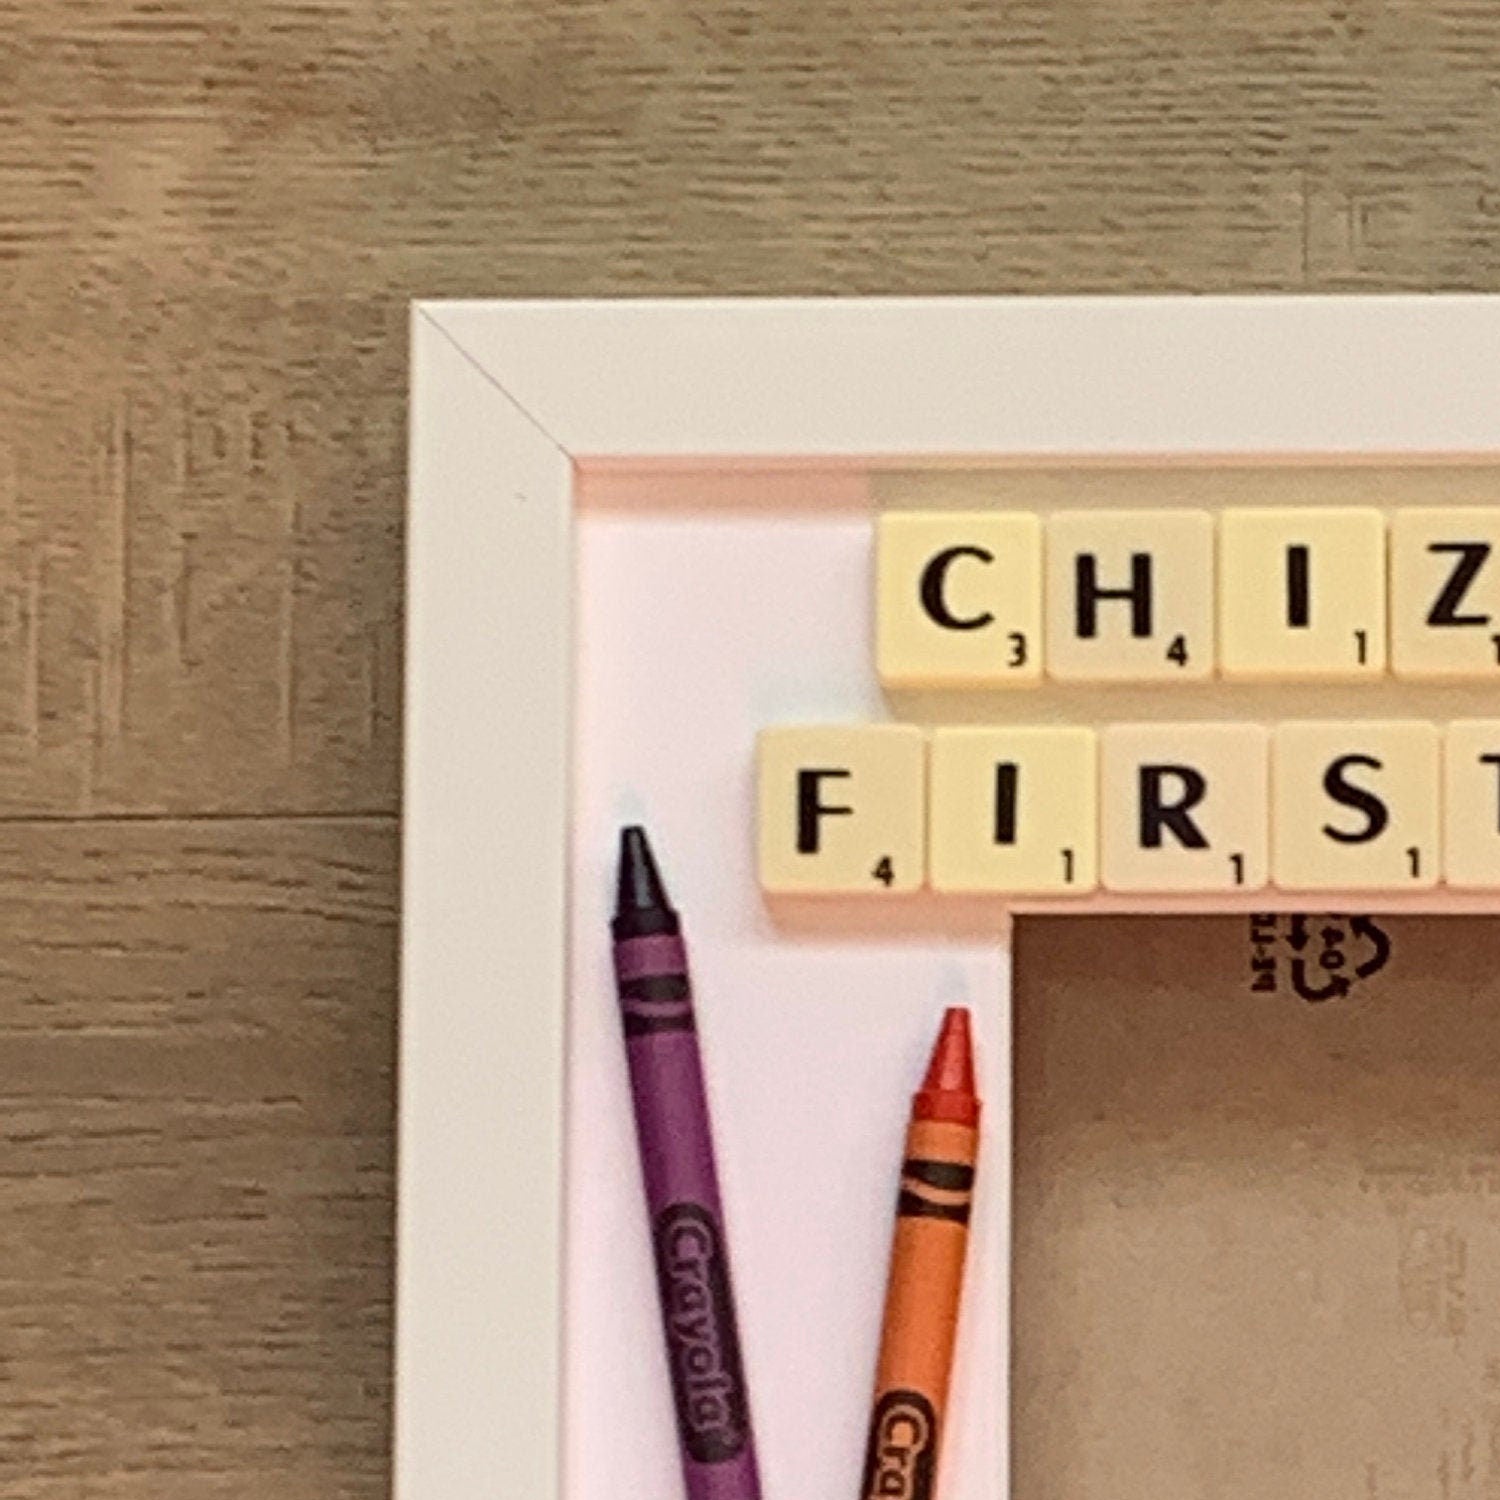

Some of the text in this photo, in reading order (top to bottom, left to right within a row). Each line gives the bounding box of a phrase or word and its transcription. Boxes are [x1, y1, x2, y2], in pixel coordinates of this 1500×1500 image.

[1008, 631, 1028, 668] 3
[1165, 634, 1189, 668] 4
[1353, 629, 1367, 665] 1
[871, 855, 896, 888] 4
[1061, 848, 1075, 883] 1
[1228, 852, 1245, 886] 1
[1405, 846, 1421, 879] 1
[665, 1216, 733, 1432] Crayola
